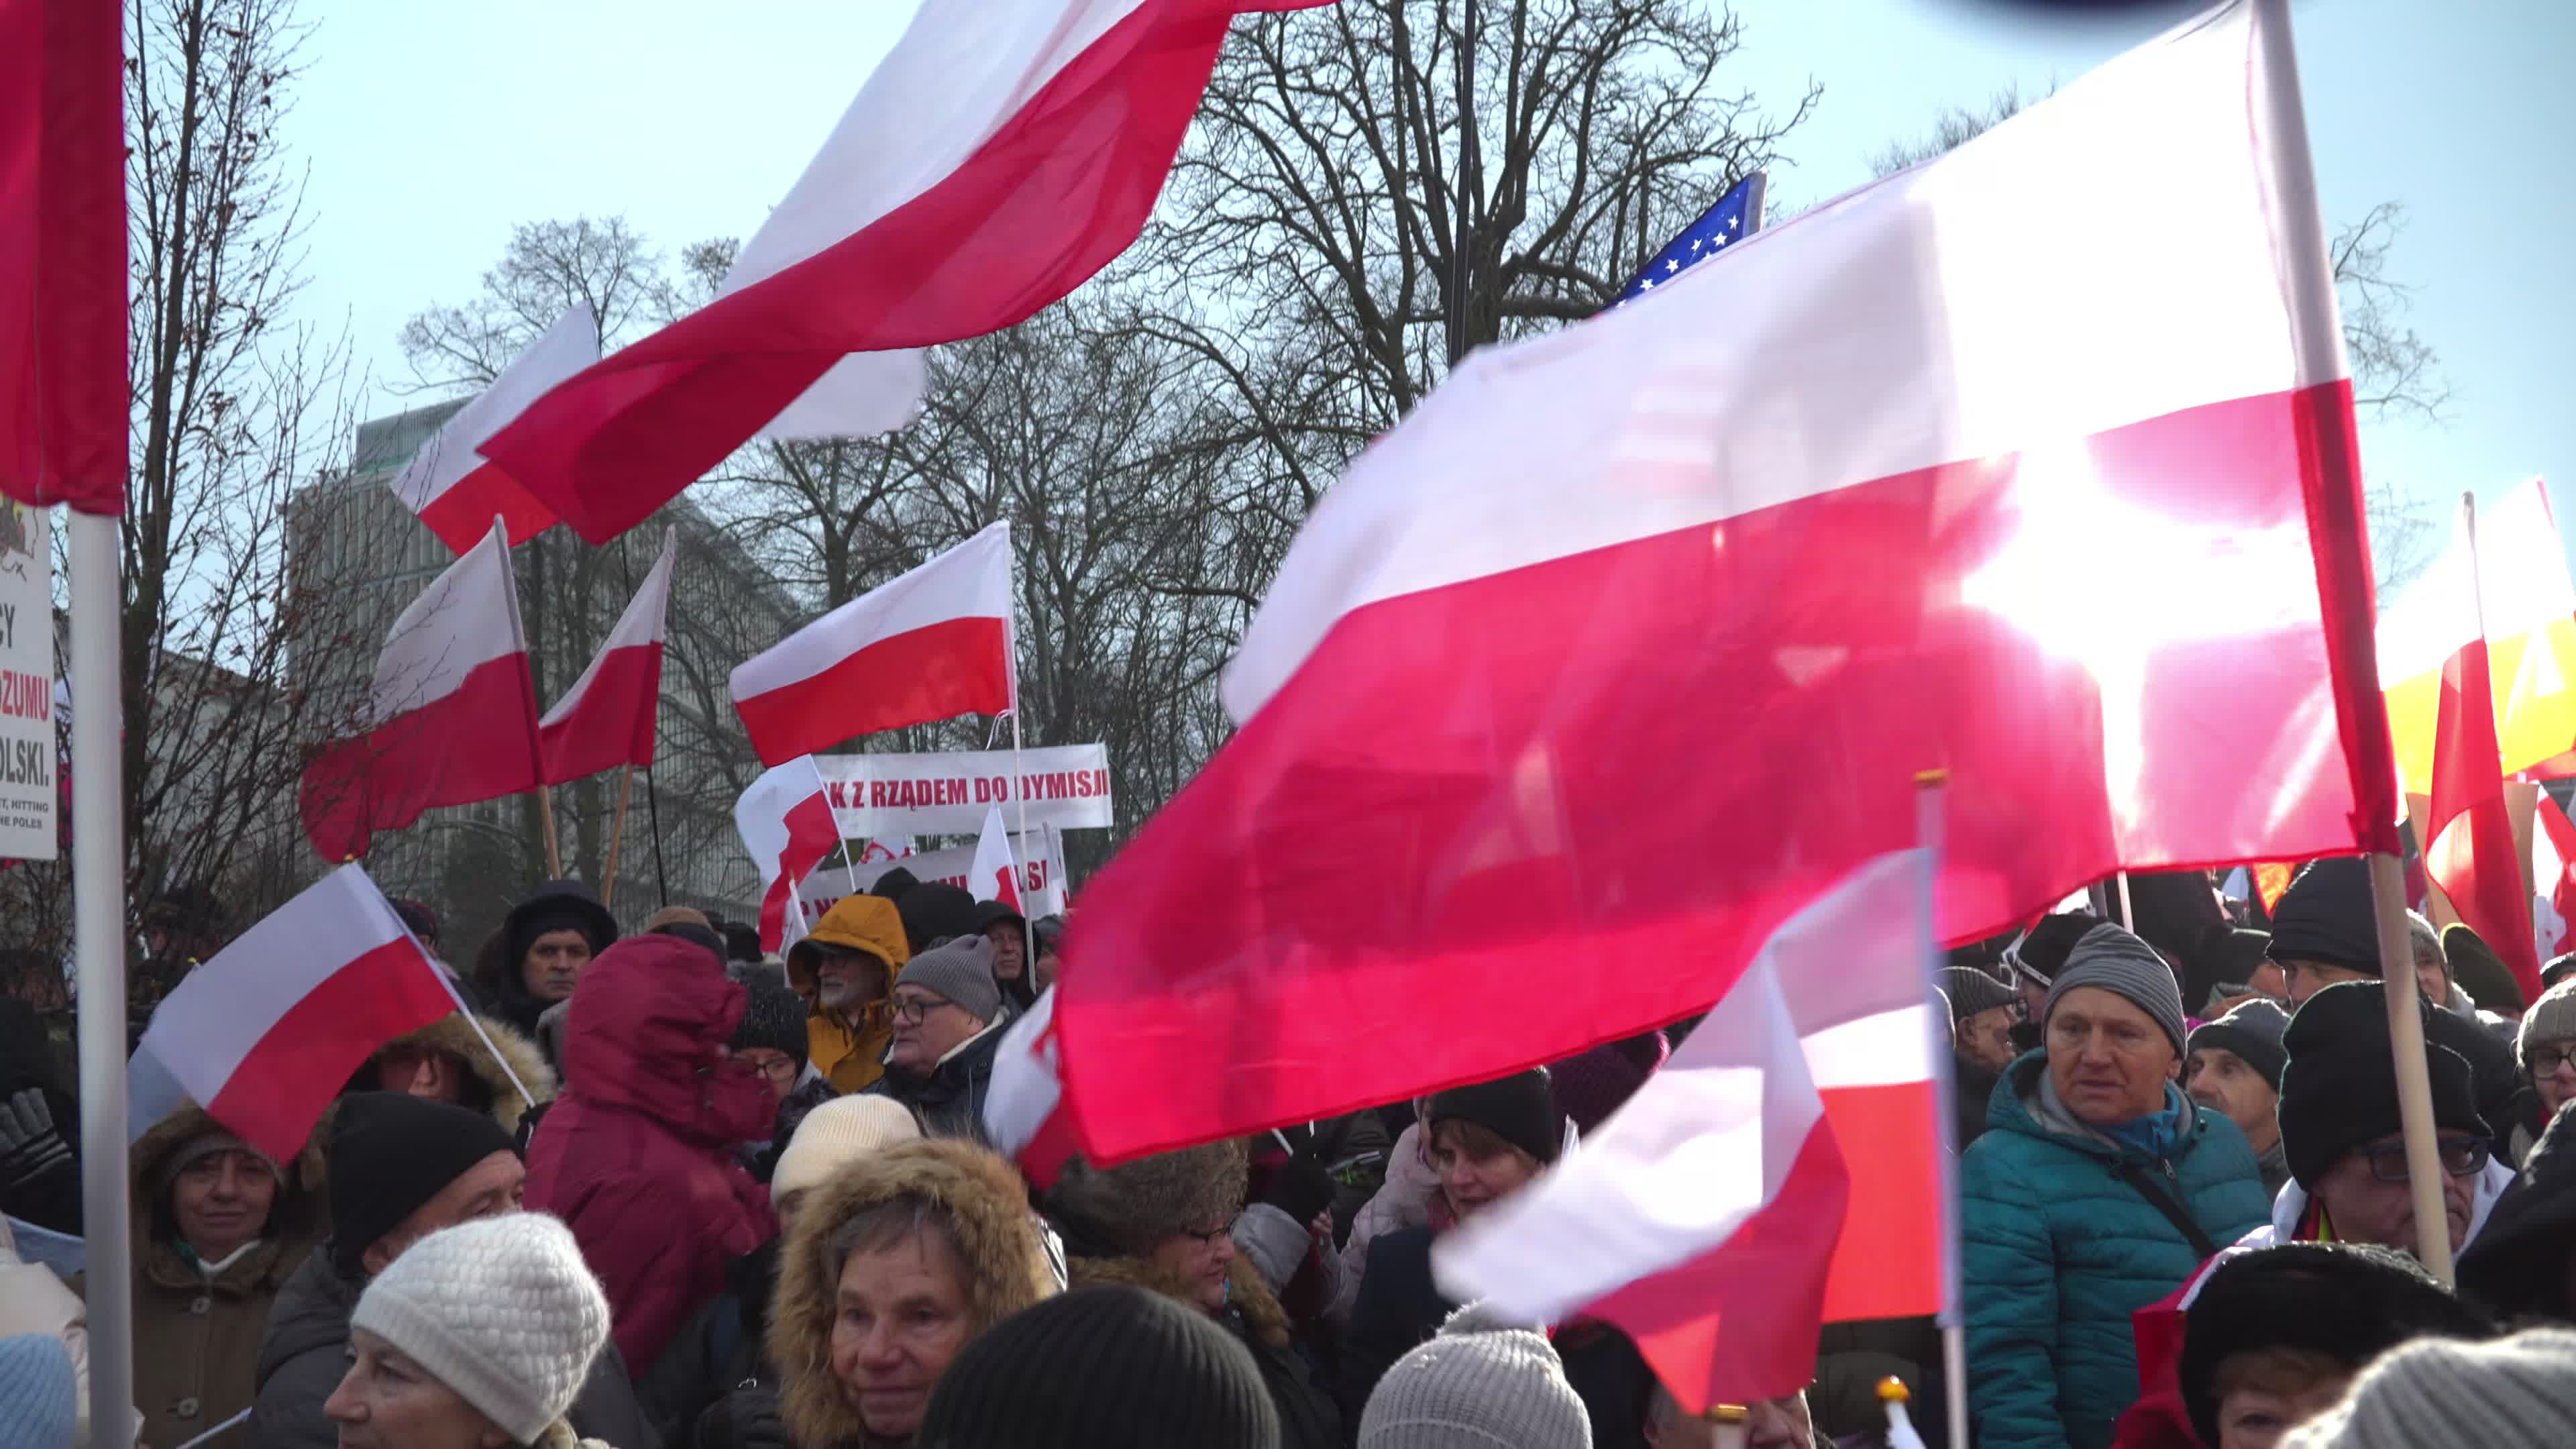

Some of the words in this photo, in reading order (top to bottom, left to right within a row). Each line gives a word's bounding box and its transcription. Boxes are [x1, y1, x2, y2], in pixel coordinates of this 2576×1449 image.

[0, 602, 15, 649] Y
[0, 669, 49, 722] ZUMU
[11, 799, 49, 813] HITTING
[852, 781, 864, 808] Z
[871, 778, 968, 811] RZĄDEM
[974, 776, 1008, 803] DO
[1014, 767, 1109, 802] DYMISJI
[13, 817, 42, 829] POLES
